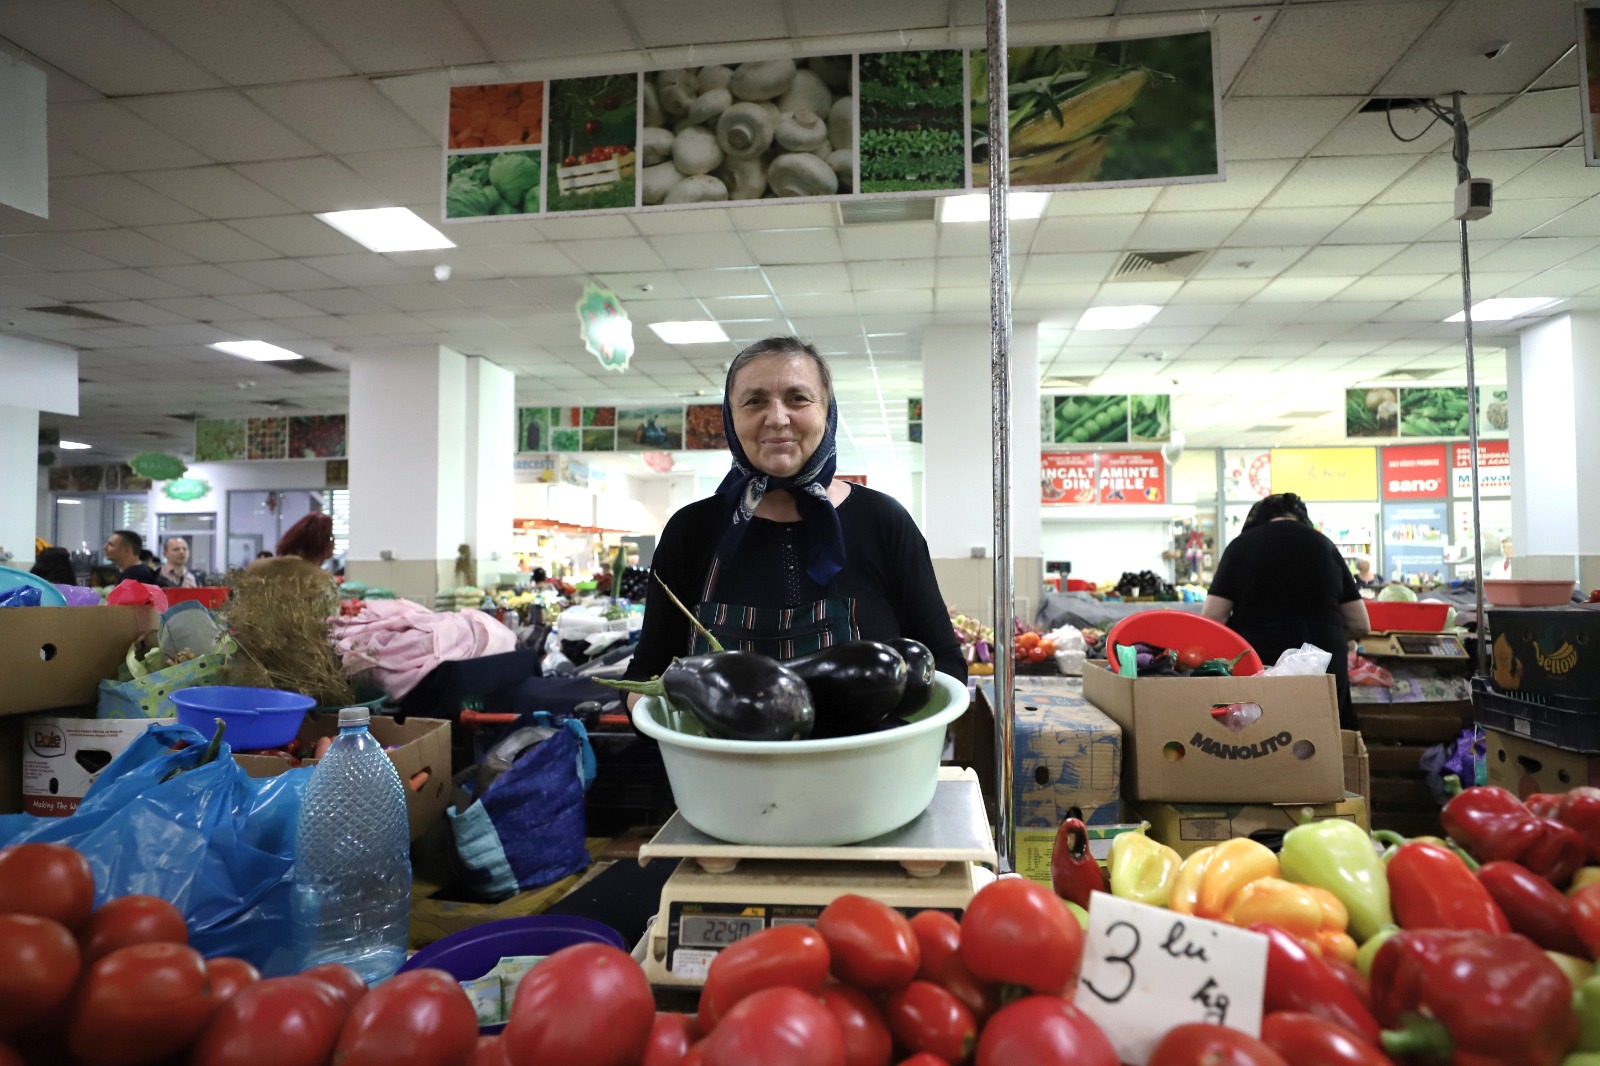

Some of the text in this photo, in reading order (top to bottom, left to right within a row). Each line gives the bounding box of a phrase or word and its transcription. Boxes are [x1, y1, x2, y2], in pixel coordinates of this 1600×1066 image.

[1488, 458, 1510, 466] ACAS
[1062, 478, 1145, 489] DIN PIELE
[1388, 478, 1438, 493] sano
[35, 731, 62, 748] Dole
[1189, 731, 1293, 760] MANOLITO
[33, 800, 54, 812] Making
[56, 801, 68, 810] The
[1081, 920, 1141, 1004] 3
[1191, 976, 1230, 1026] kg
